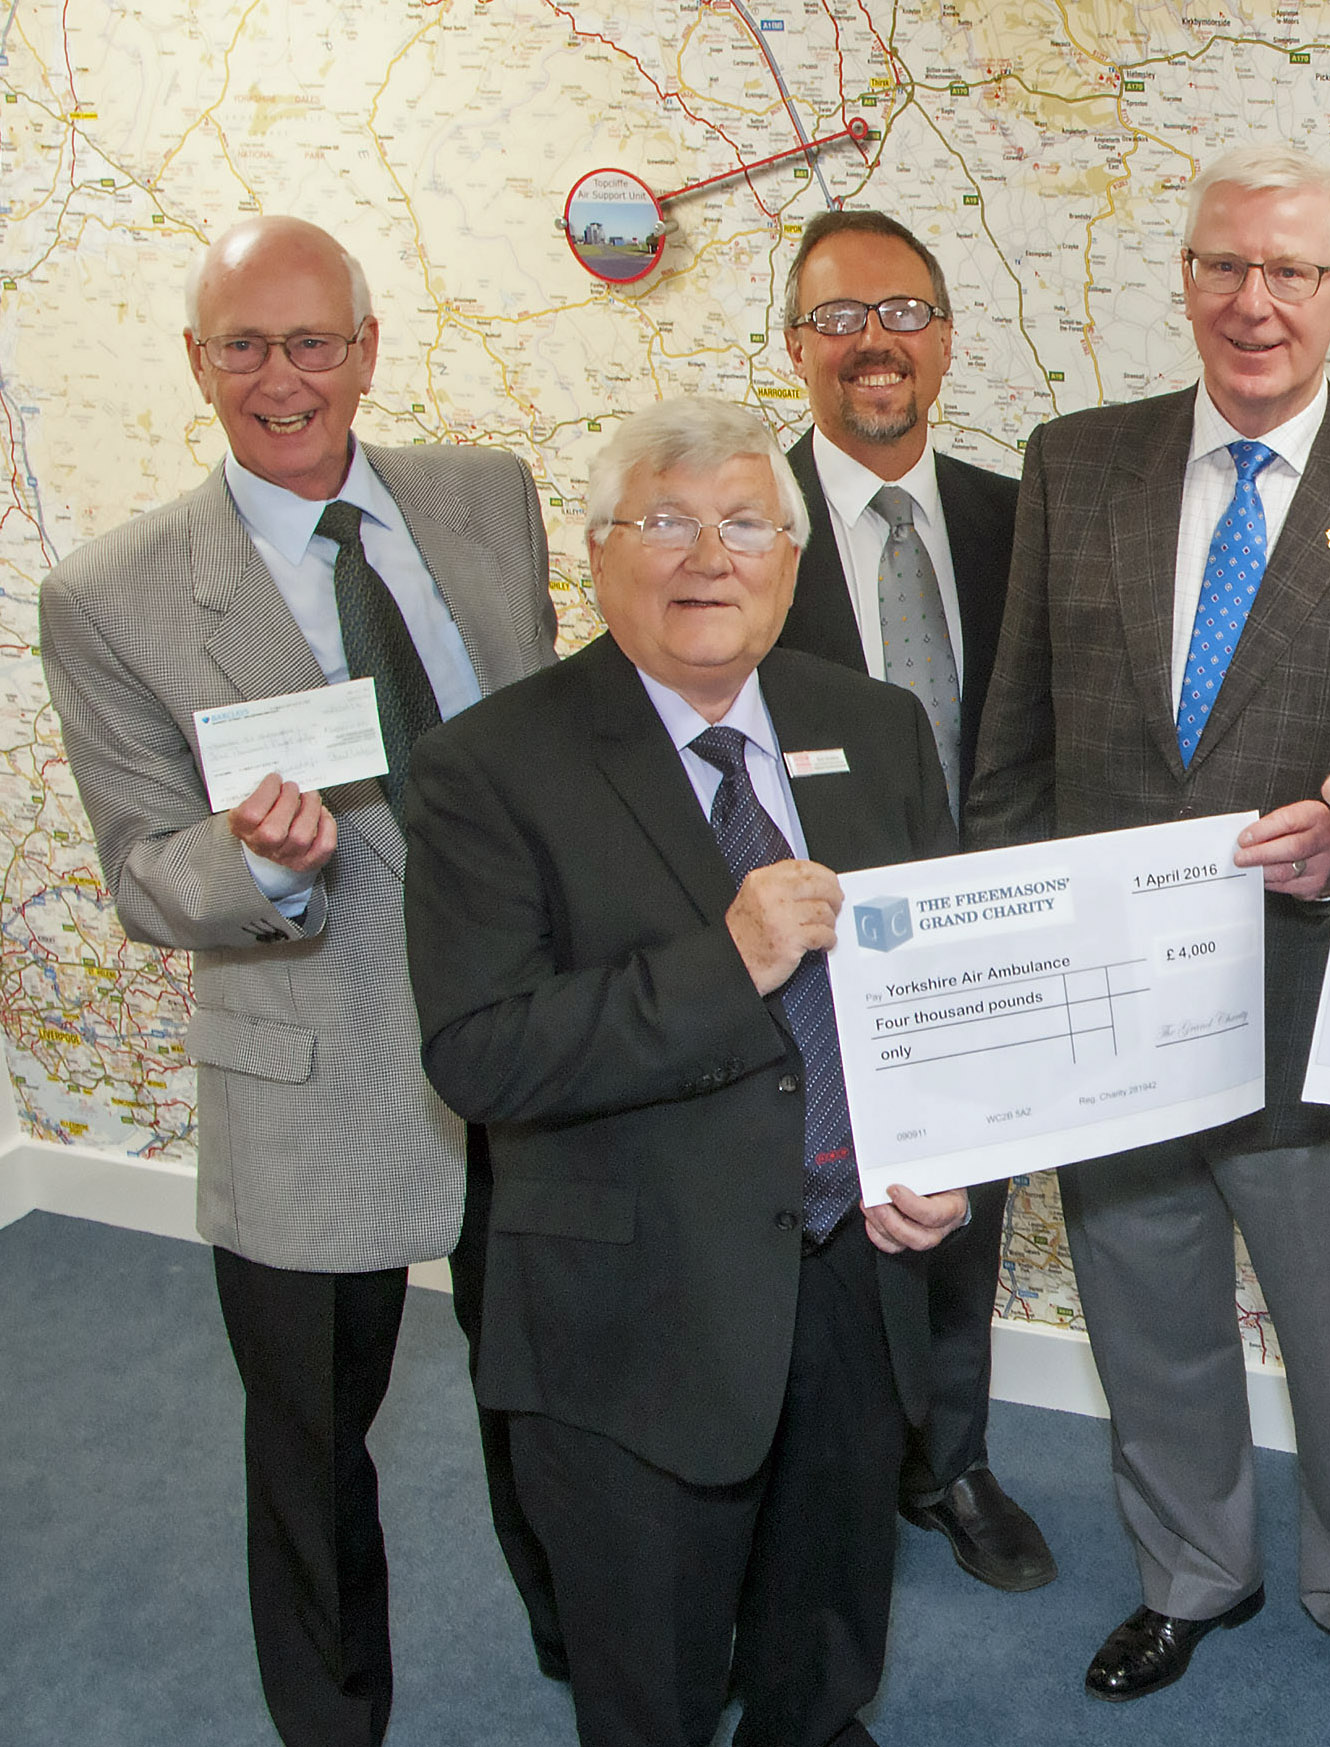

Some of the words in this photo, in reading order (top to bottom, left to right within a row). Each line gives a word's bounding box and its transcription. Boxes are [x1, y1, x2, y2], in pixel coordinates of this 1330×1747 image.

[1127, 71, 1155, 79] Helmsley
[238, 150, 274, 160] NATIONAL
[305, 151, 326, 160] PARK
[593, 179, 628, 187] Topcliffe
[578, 191, 588, 199] Air
[592, 191, 625, 200] Support
[629, 191, 646, 200] Unit
[759, 388, 800, 399] HARROGATE
[1133, 876, 1140, 887] 1
[1146, 868, 1179, 890] April
[1184, 864, 1217, 879] 2016
[916, 897, 950, 913] THE
[919, 911, 978, 931] GRAND
[983, 899, 1055, 920] CHARITY
[1166, 948, 1175, 961] £
[1179, 941, 1216, 959] 4,000
[886, 972, 957, 998] Yorkshire
[961, 969, 982, 983] Air
[987, 955, 1070, 979] Ambulance
[876, 1015, 909, 1030] Four
[914, 1001, 984, 1023] thousand
[988, 991, 1043, 1015] pounds
[39, 1029, 80, 1044] LIVERPOOL
[880, 1044, 912, 1061] only
[1099, 1090, 1127, 1102] Charity
